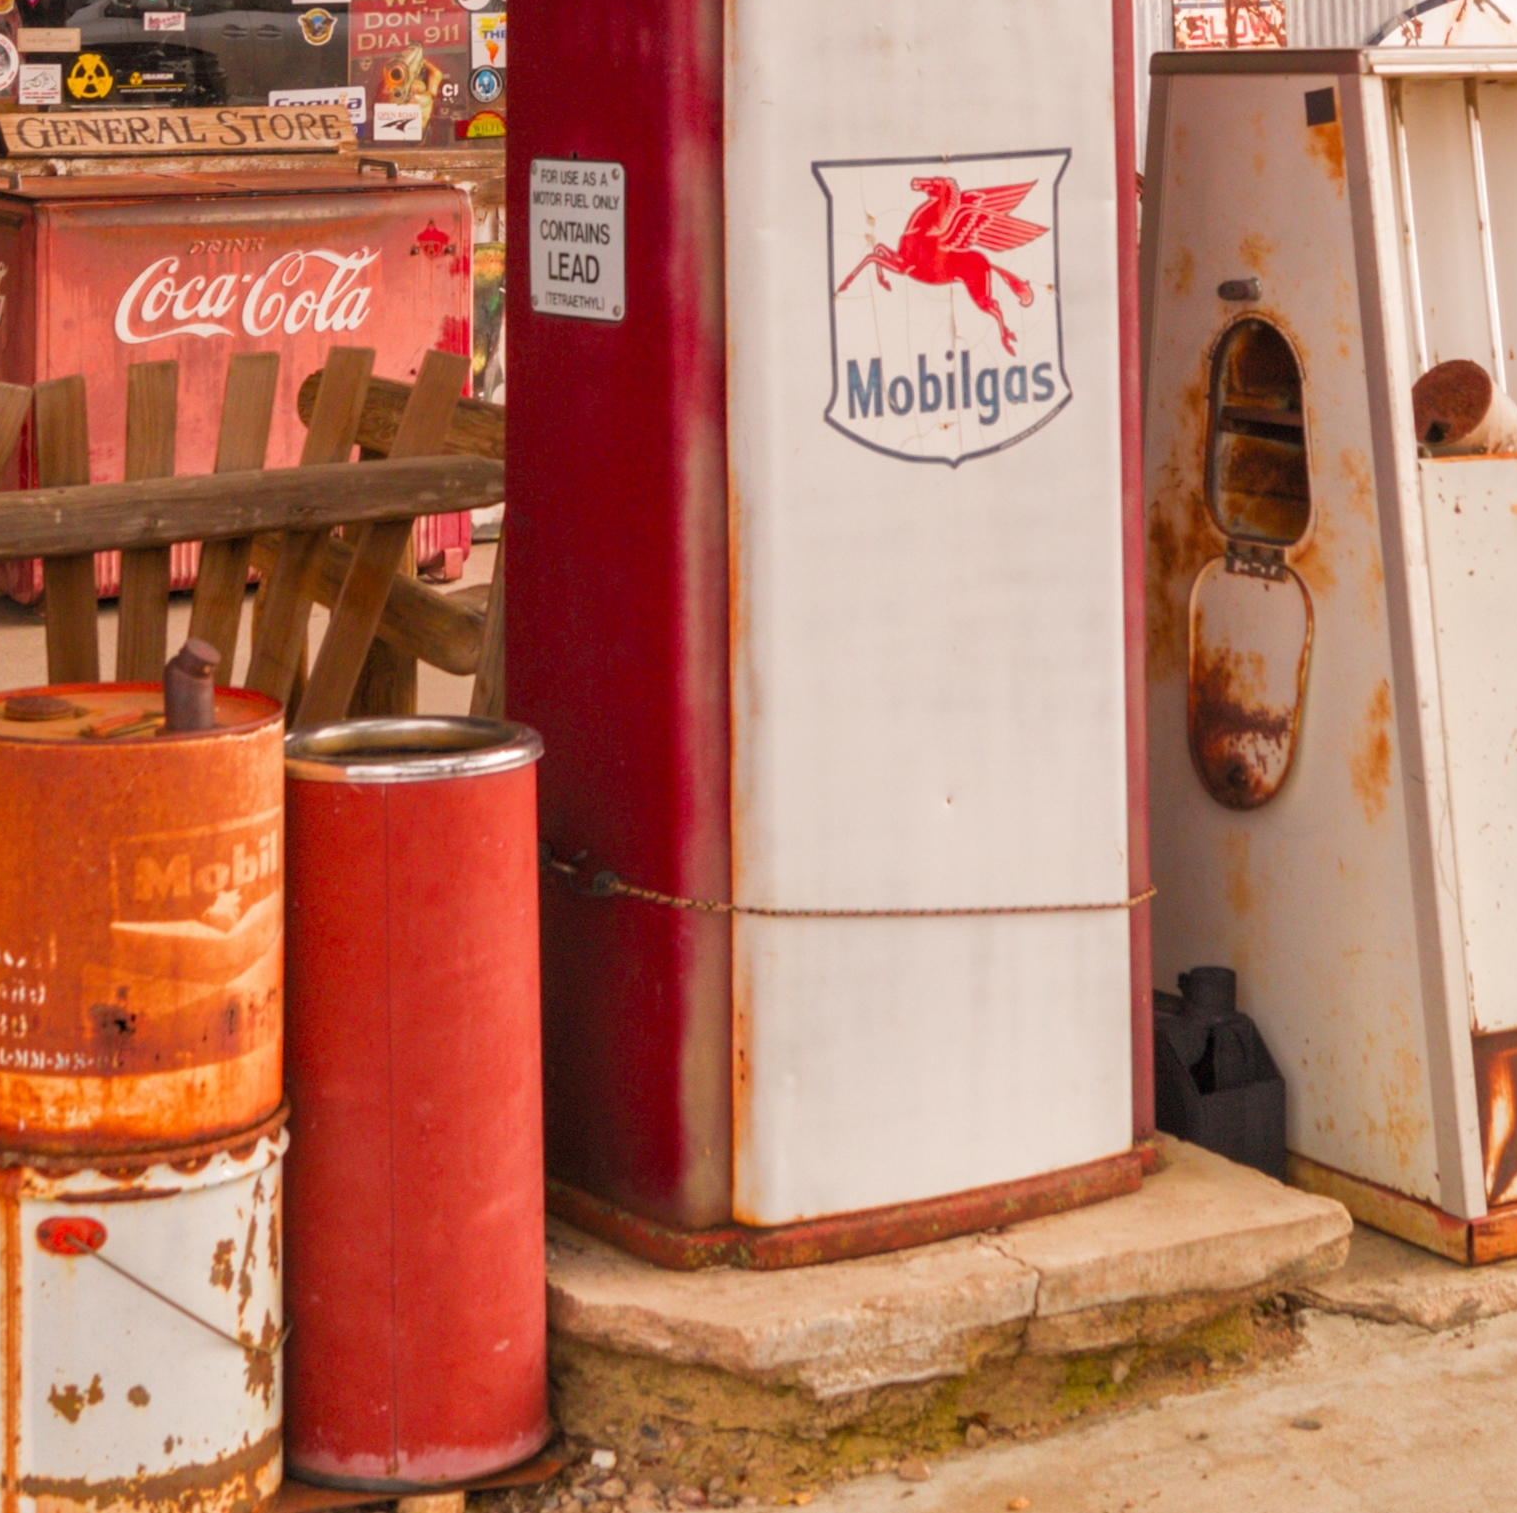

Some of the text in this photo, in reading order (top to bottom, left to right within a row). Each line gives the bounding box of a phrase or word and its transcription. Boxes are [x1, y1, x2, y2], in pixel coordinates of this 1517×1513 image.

[365, 7, 445, 30] DON'T
[1188, 9, 1273, 40] SLOW
[424, 24, 460, 43] 911
[377, 111, 419, 119] OPEN ROAD
[16, 110, 342, 149] GENERAL STORE
[540, 168, 608, 187] FOR USE AS A
[533, 191, 620, 210] MOTOR FUEL ONLY
[540, 219, 610, 245] CONTAINS
[189, 236, 266, 255] DRINK
[548, 251, 600, 284] LEAD
[113, 245, 382, 345] Coca-Cola
[545, 291, 605, 312] (TETRAETHYL)
[846, 349, 1055, 426] Mobilgas
[133, 829, 280, 902] Mobil
